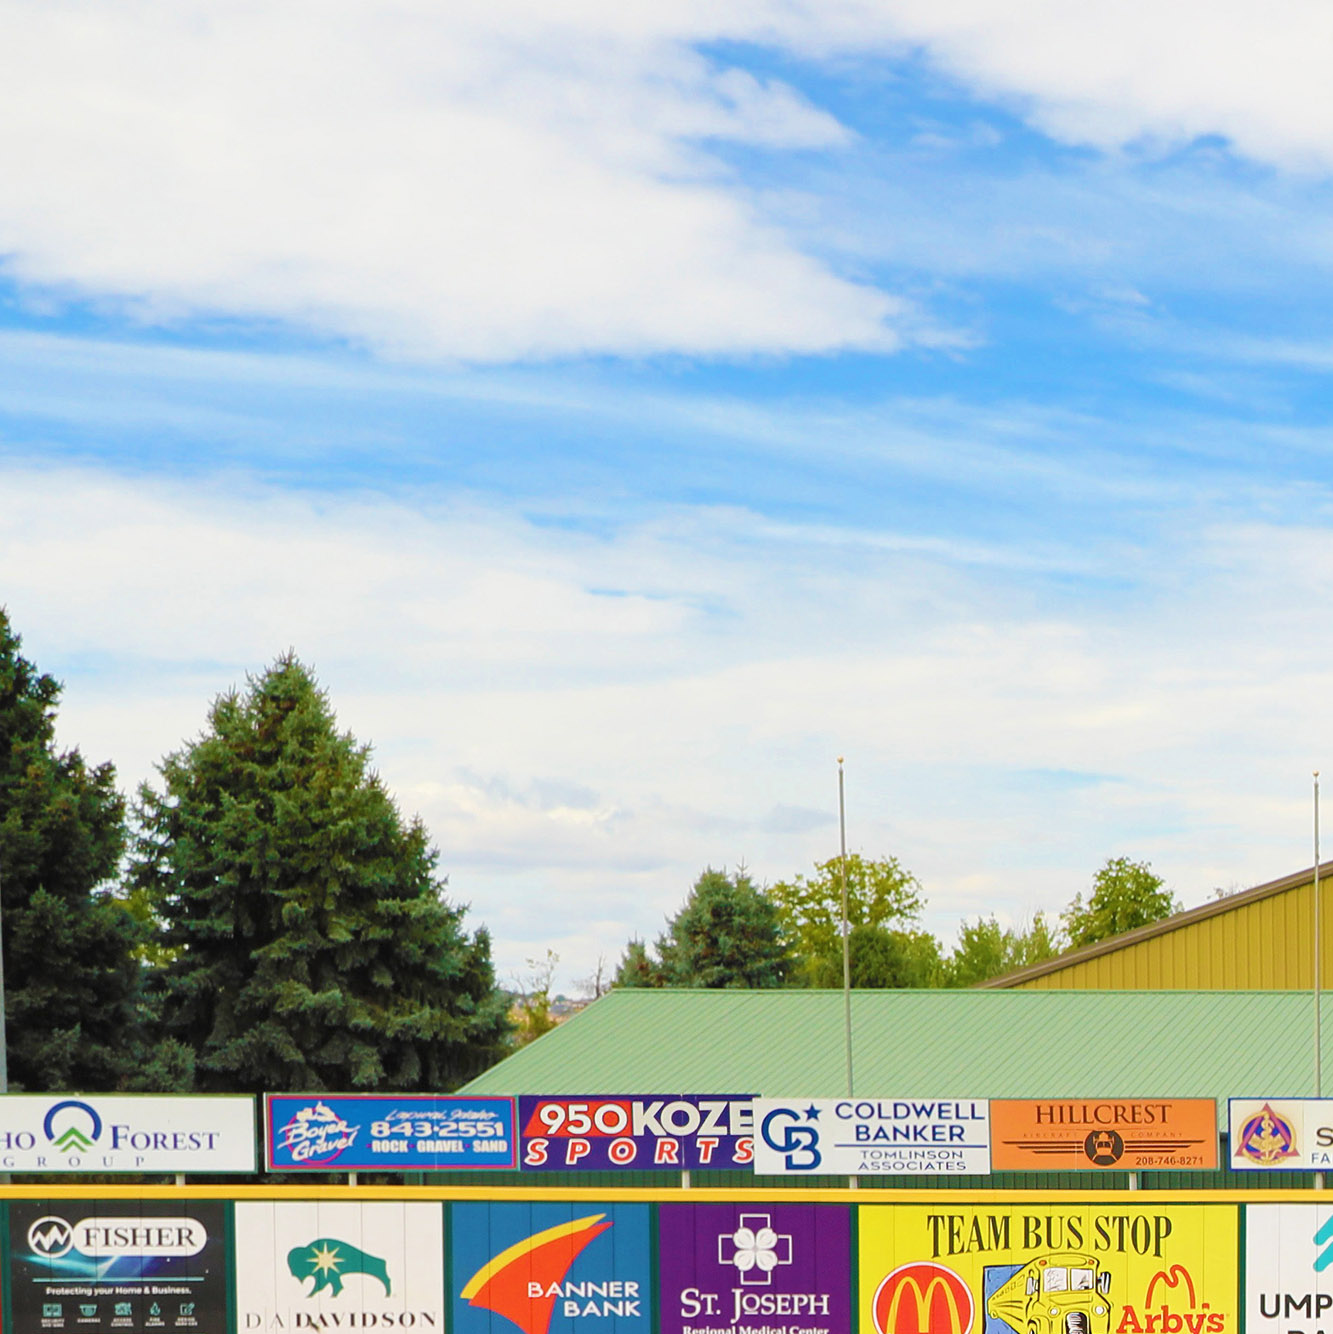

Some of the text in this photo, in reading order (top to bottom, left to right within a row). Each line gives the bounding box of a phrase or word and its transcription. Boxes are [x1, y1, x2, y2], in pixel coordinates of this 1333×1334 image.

[834, 1102, 986, 1120] COLDWELL
[1035, 1104, 1172, 1125] HILLCREST
[109, 1125, 220, 1150] FOREST
[277, 1120, 361, 1148] Boyer
[855, 1124, 966, 1142] BANKER
[291, 1130, 359, 1161] Gravel
[372, 1140, 508, 1153] ROCK GRAVEL SAND
[524, 1137, 754, 1168] SPORTS
[860, 1151, 964, 1160] TOMLINSON
[858, 1161, 967, 1171] ASSOCIATES
[83, 1227, 197, 1247] FISHER
[927, 1214, 1172, 1258] TEAM BUS STOP
[46, 1286, 192, 1298] Protecting your Home Business.
[527, 1281, 640, 1298] BANNER
[563, 1300, 642, 1317] BANK
[681, 1288, 830, 1323] ST. JOSEPH
[295, 1311, 437, 1329] DAVIDSON
